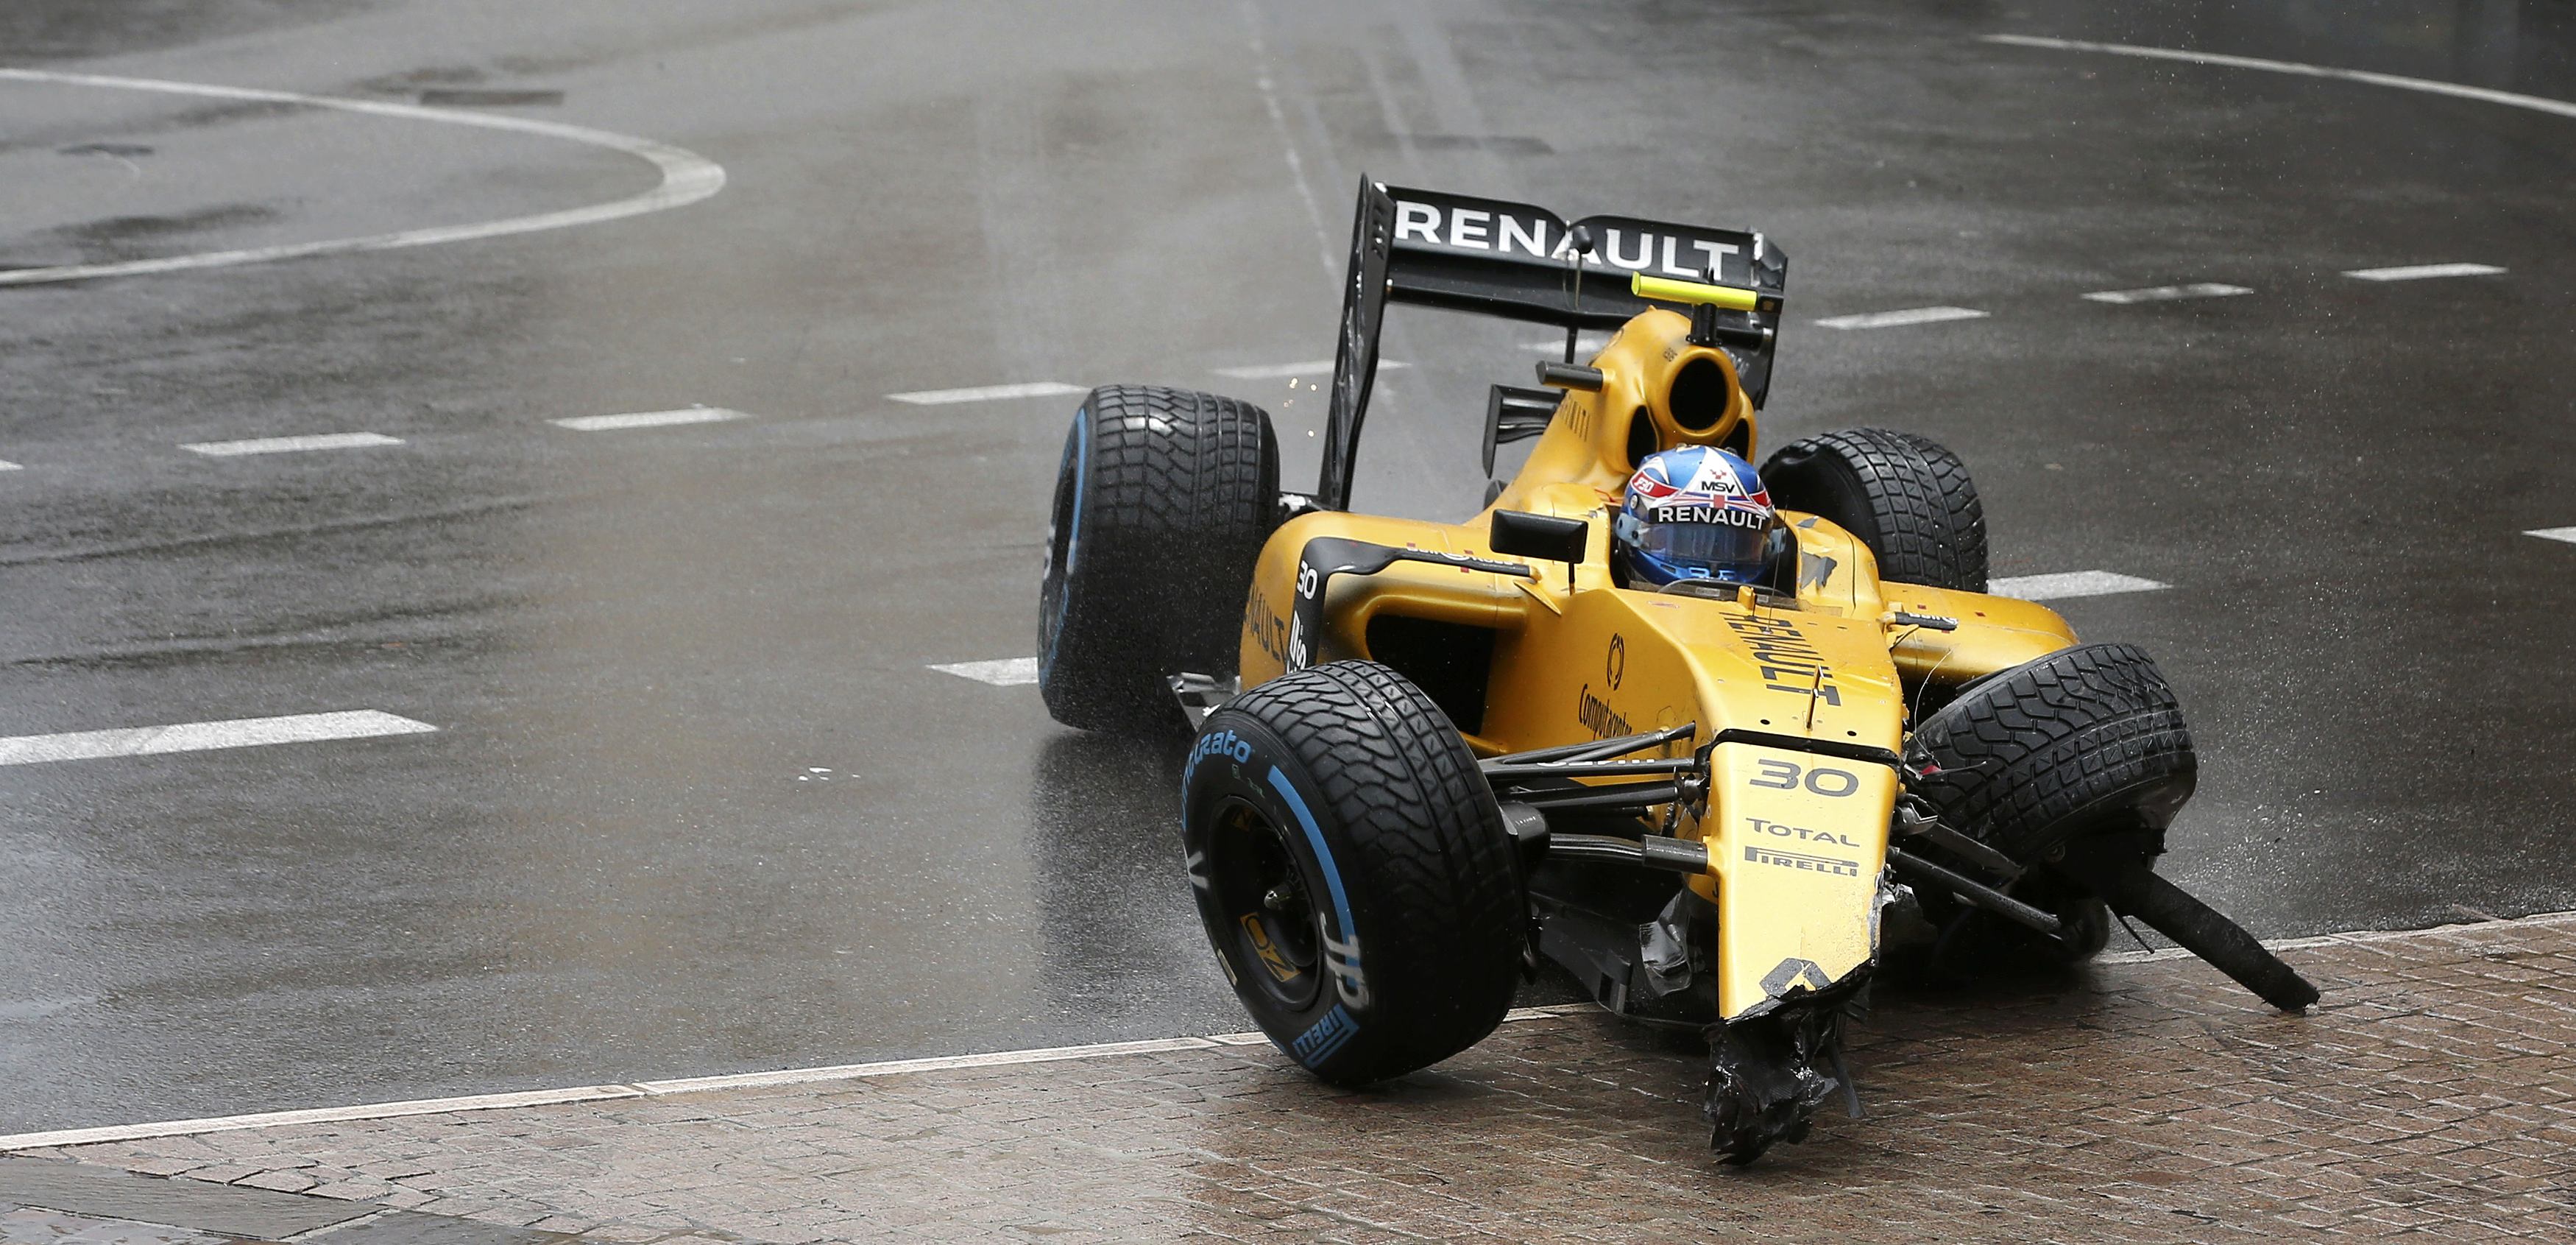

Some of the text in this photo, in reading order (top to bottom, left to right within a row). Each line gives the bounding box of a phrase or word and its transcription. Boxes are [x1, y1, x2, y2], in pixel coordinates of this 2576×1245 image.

[1395, 200, 1739, 281] RENAULT
[1701, 481, 1735, 493] MSV
[1657, 506, 1766, 531] RENAULT
[1296, 560, 1318, 600] 30
[1719, 611, 1841, 707] RENAULT
[1749, 758, 1859, 797] 30
